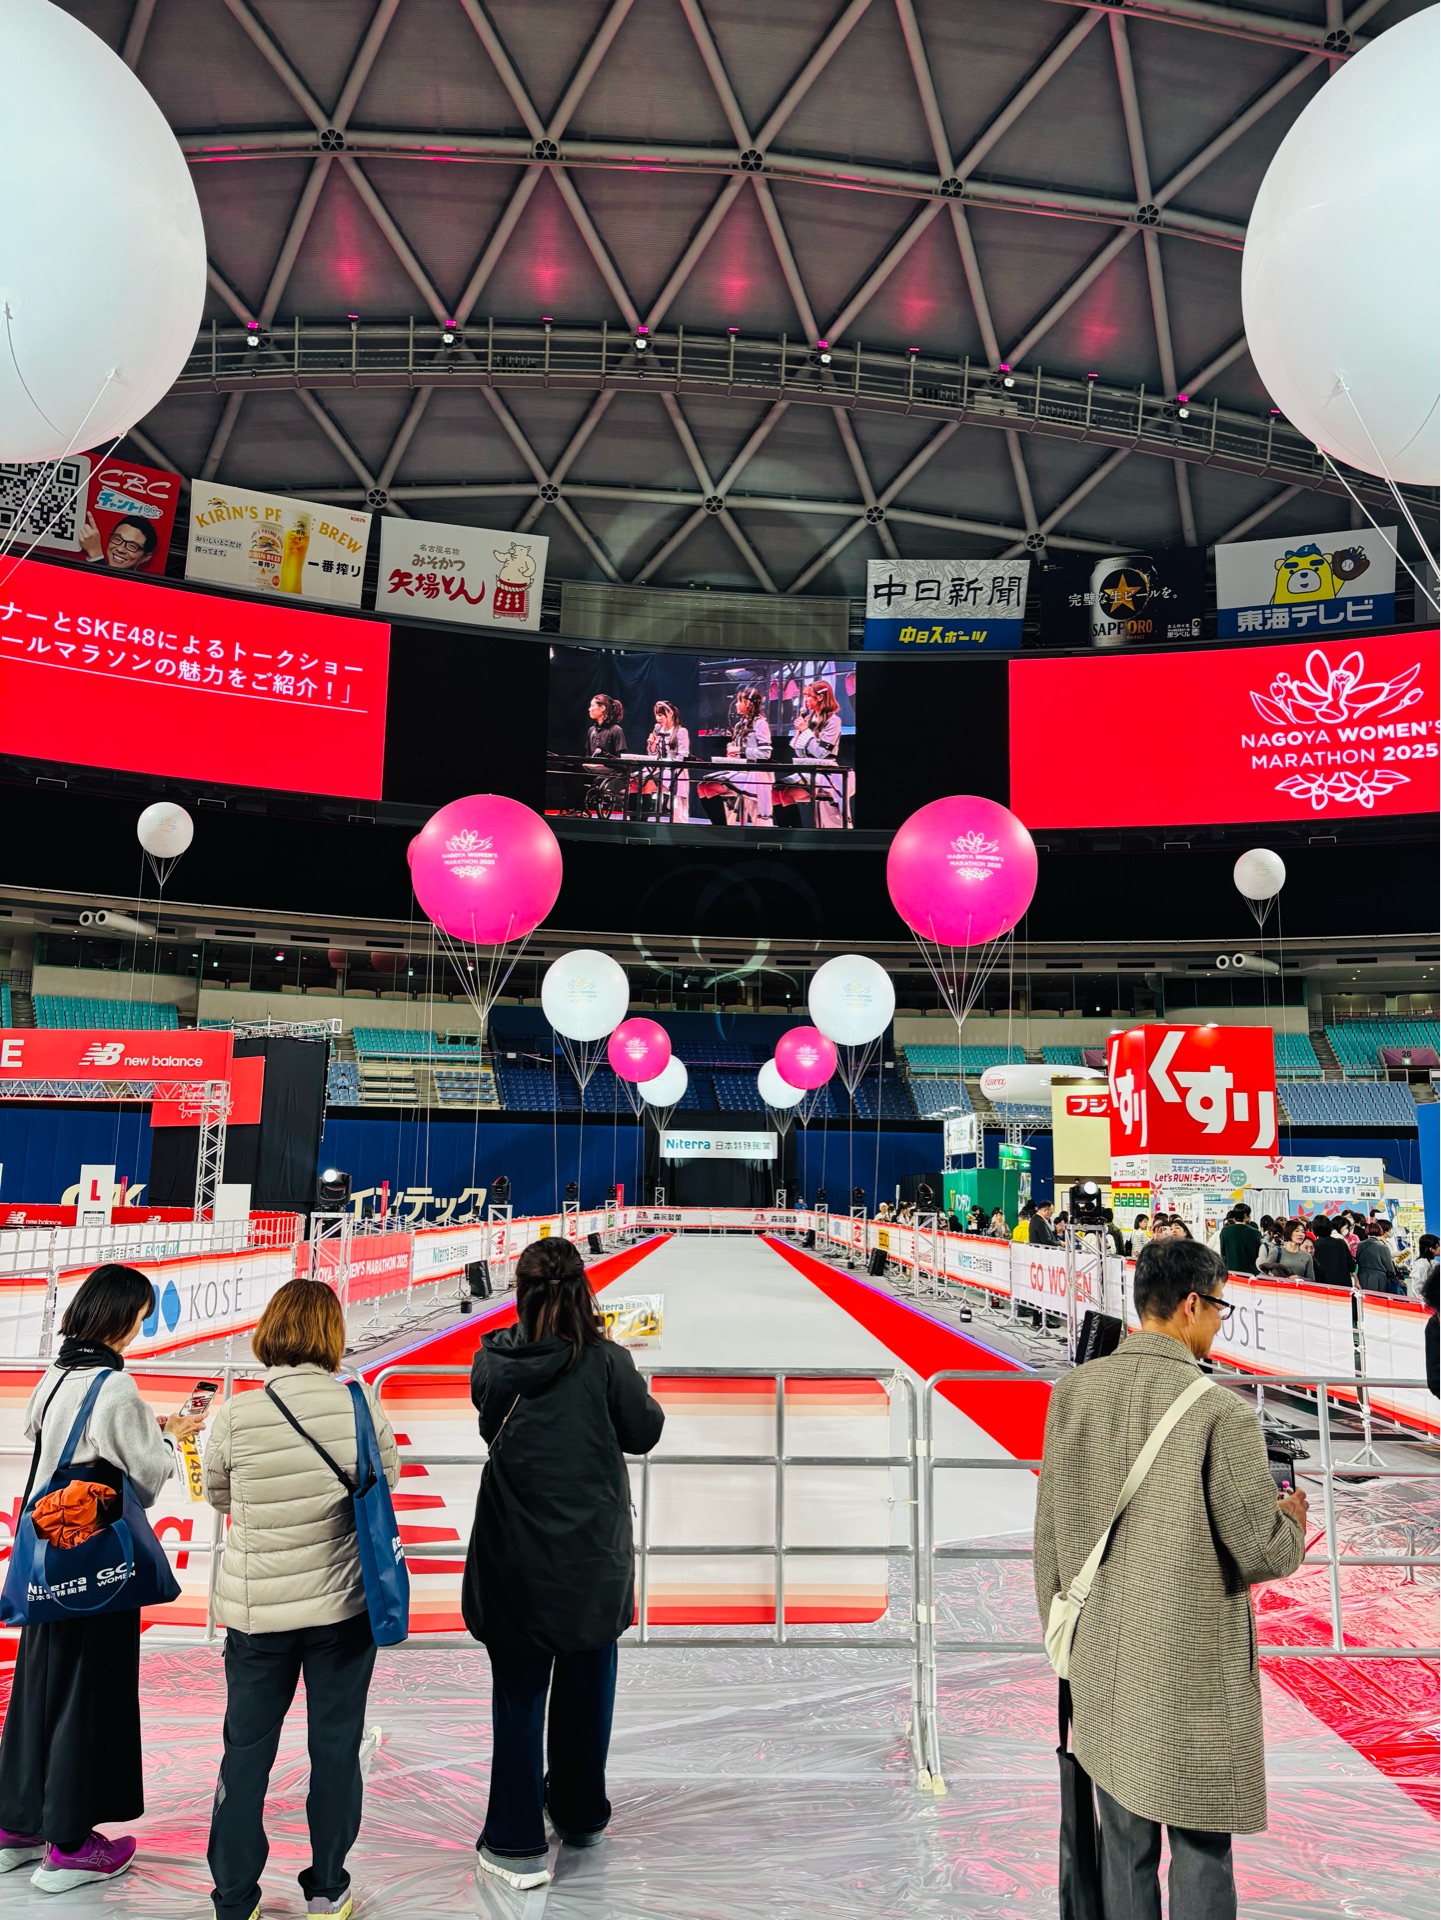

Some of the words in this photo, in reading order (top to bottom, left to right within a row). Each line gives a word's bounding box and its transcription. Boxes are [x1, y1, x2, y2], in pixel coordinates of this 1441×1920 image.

[98, 469, 171, 499] CBC
[195, 506, 258, 528] KIRIN'S
[318, 521, 363, 554] BREW
[350, 516, 366, 524] KIRIN
[196, 535, 242, 549] おいしいとこだけ
[419, 543, 460, 556] 名古屋名物
[308, 560, 361, 578] 一番搾り
[411, 553, 466, 572] みそかつ
[387, 568, 486, 605] 矢場とん
[873, 574, 1023, 608] 中日新聞
[1068, 586, 1178, 608] 完璧な生ビールを。
[1237, 599, 1373, 633] 東海テレビ
[0, 601, 363, 675] ナーとSKE48によるトークショー
[899, 626, 987, 644] 中日スポーツ
[1092, 619, 1153, 637] SAPPORO
[1241, 730, 1330, 748] NAGOYA
[1337, 720, 1440, 742] WOMEN'S
[1252, 747, 1375, 769] MARATHON
[1382, 742, 1439, 761] 2025
[124, 1056, 150, 1067] new
[152, 1055, 203, 1068] balance
[1108, 1040, 1147, 1147] くすり
[1148, 1031, 1274, 1149] くすり
[1070, 1098, 1110, 1113] フジ
[666, 1138, 711, 1150] Niterra
[1155, 1173, 1172, 1182] Let's
[90, 1180, 100, 1200] L
[365, 1255, 396, 1275] MARATHON
[396, 1253, 408, 1269] 2025
[1030, 1262, 1044, 1292] GO
[1048, 1266, 1092, 1303] WOEN
[189, 1268, 243, 1322] KOSÉ
[1216, 1299, 1266, 1351] OSÉ
[97, 1570, 136, 1587] WOMEN
